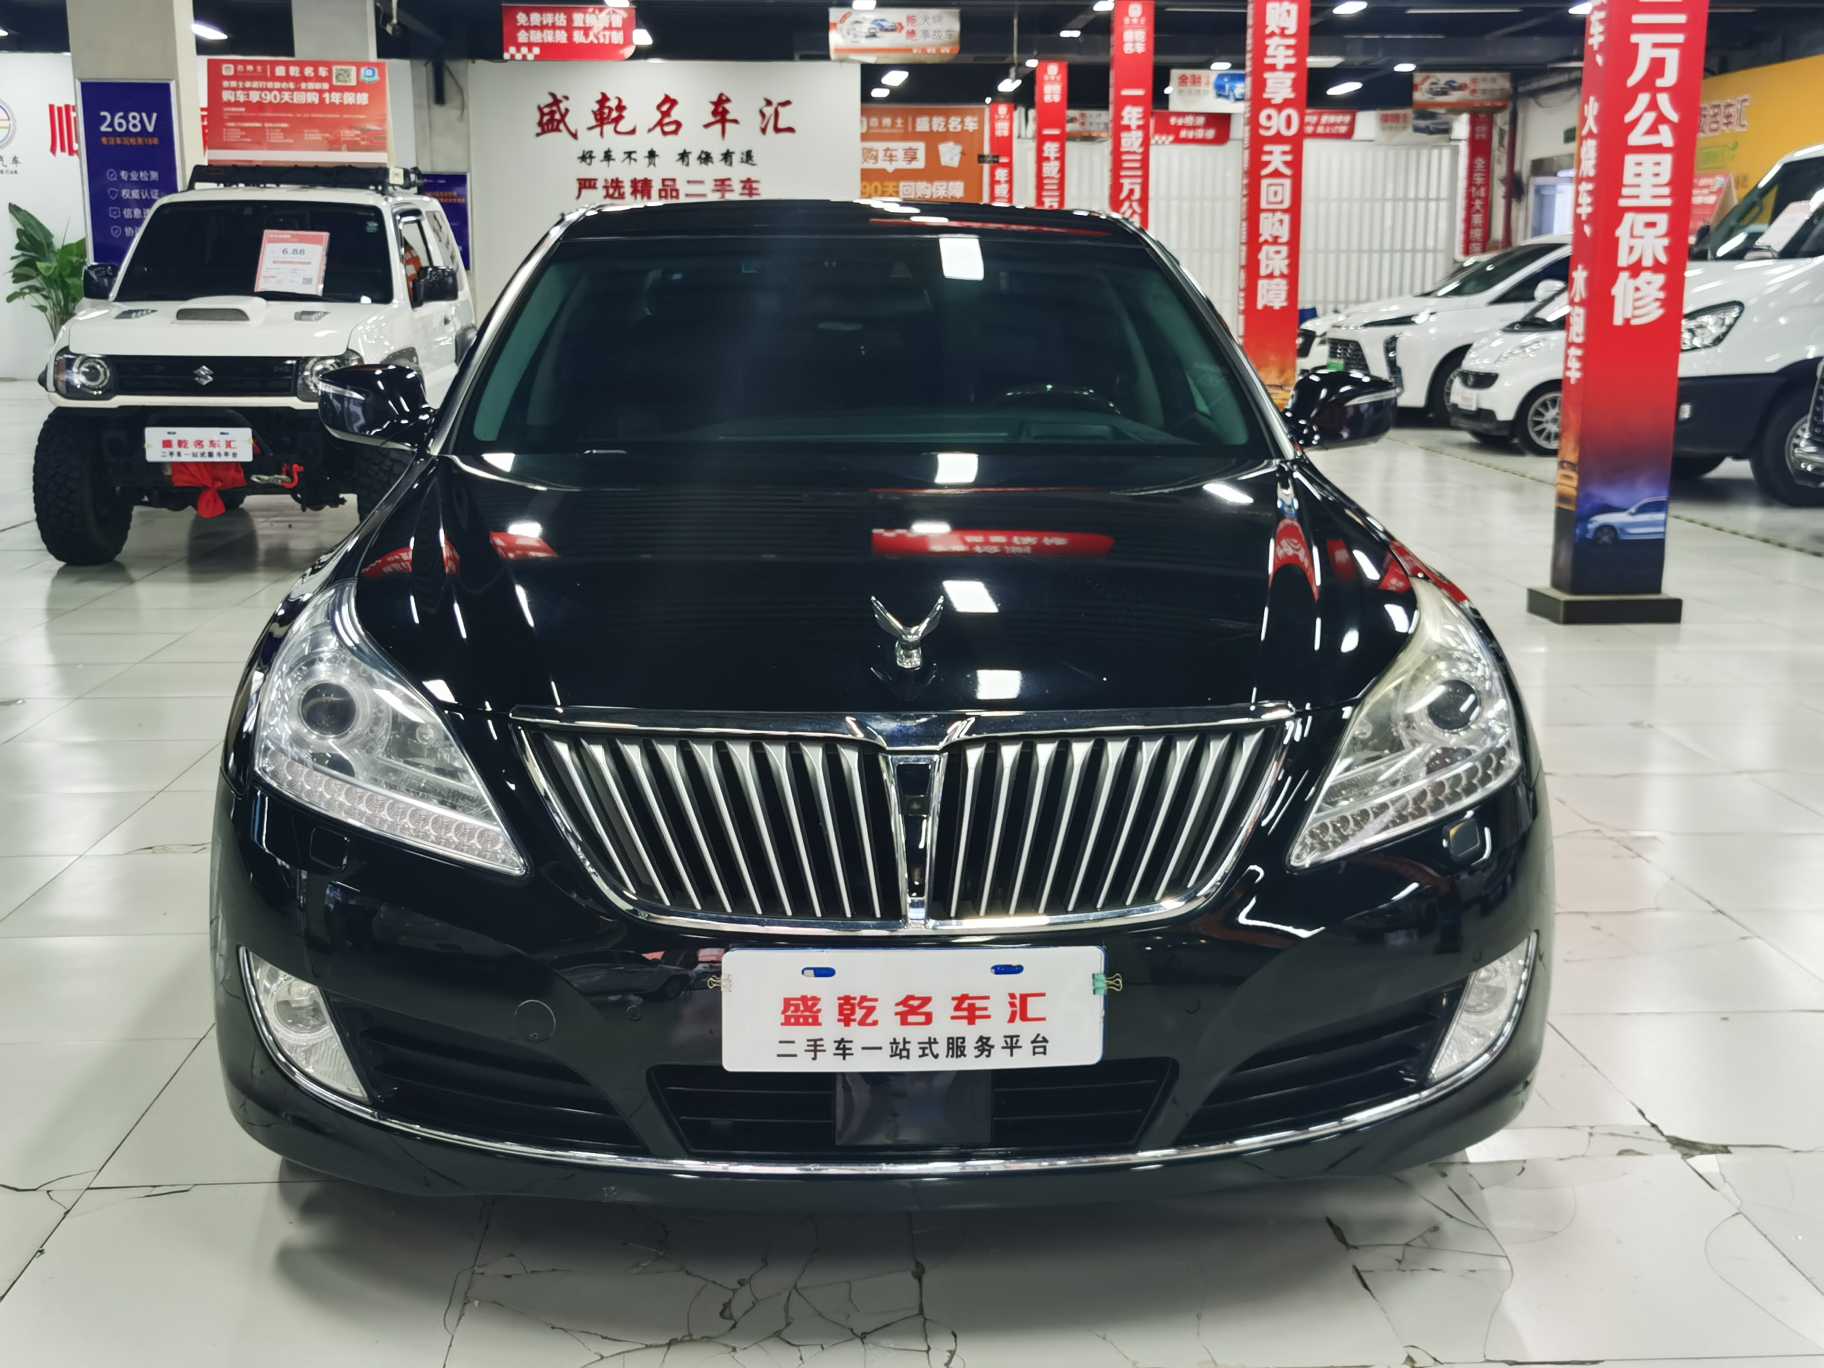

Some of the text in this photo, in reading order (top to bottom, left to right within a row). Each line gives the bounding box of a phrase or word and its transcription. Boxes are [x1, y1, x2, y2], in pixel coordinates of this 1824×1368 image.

[99, 111, 157, 132] 268V
[535, 91, 796, 141] 盛乾名车汇
[577, 149, 660, 168] 好车不贵
[862, 147, 919, 164] 购车享
[1256, 2, 1299, 310] 购车享90天回购保障
[576, 177, 761, 200] 严选精品二手车
[994, 156, 1010, 204] 一年或
[780, 992, 1048, 1027] 盛乾名车汇
[776, 1033, 1050, 1061] 二手车一站式服务平台
